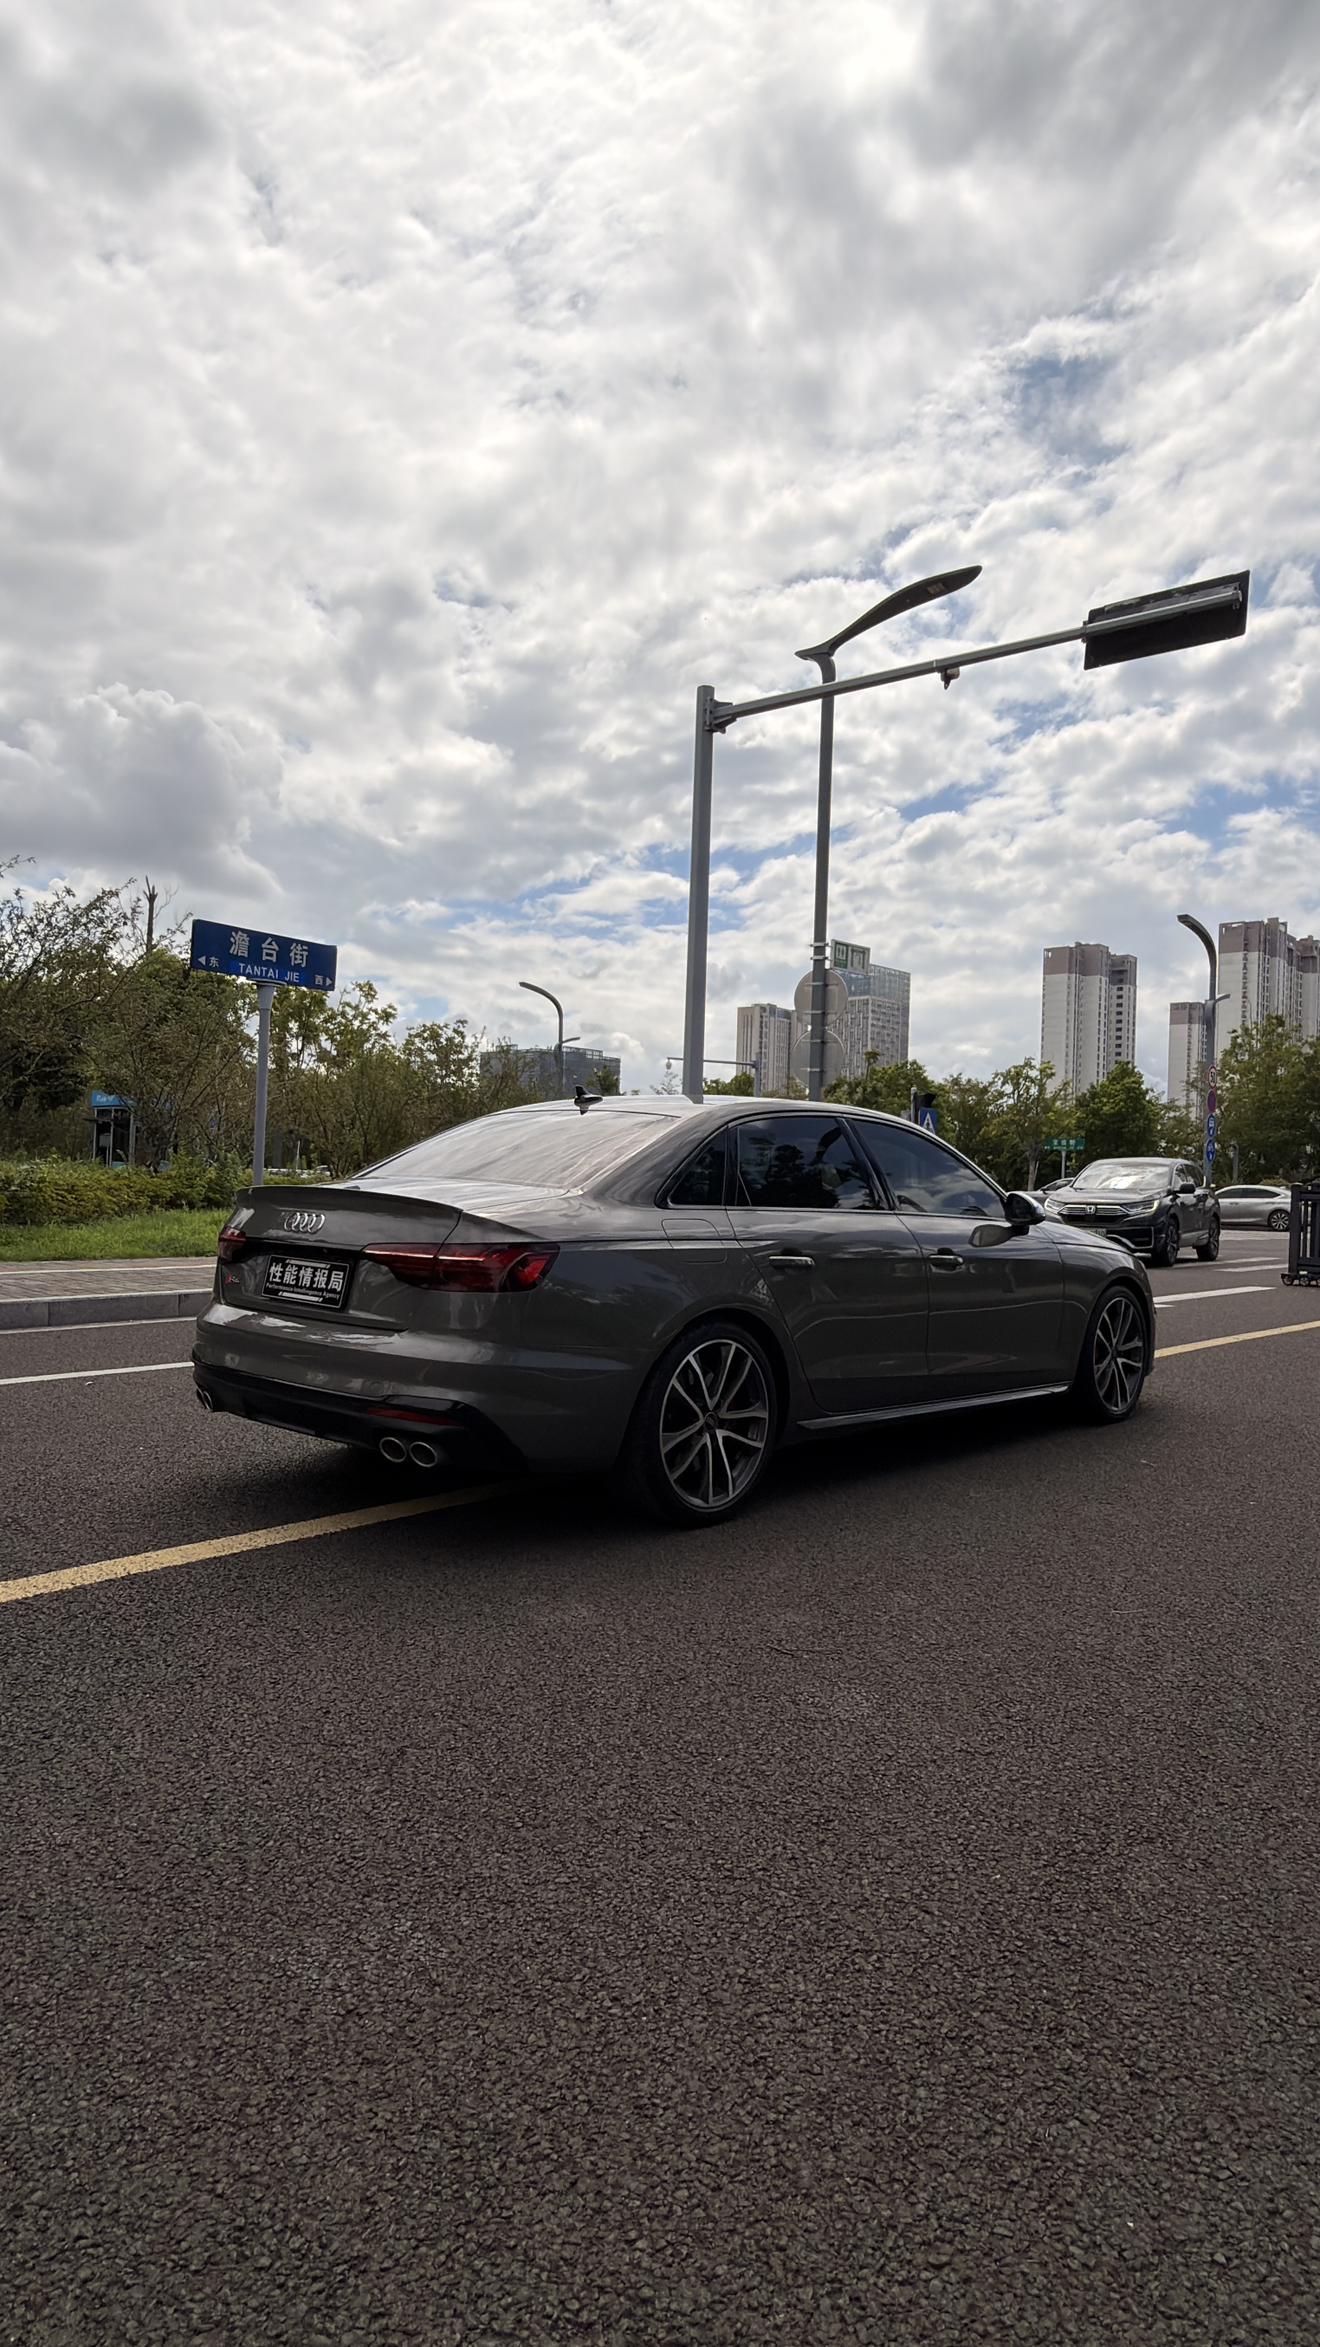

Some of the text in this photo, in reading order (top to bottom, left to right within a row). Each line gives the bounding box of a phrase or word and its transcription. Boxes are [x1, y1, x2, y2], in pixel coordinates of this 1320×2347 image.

[229, 930, 309, 968] 澹台街
[209, 956, 220, 968] 东
[239, 963, 300, 983] TANTAI JIE
[314, 974, 324, 985] 西
[269, 1262, 344, 1292] 性能情报局
